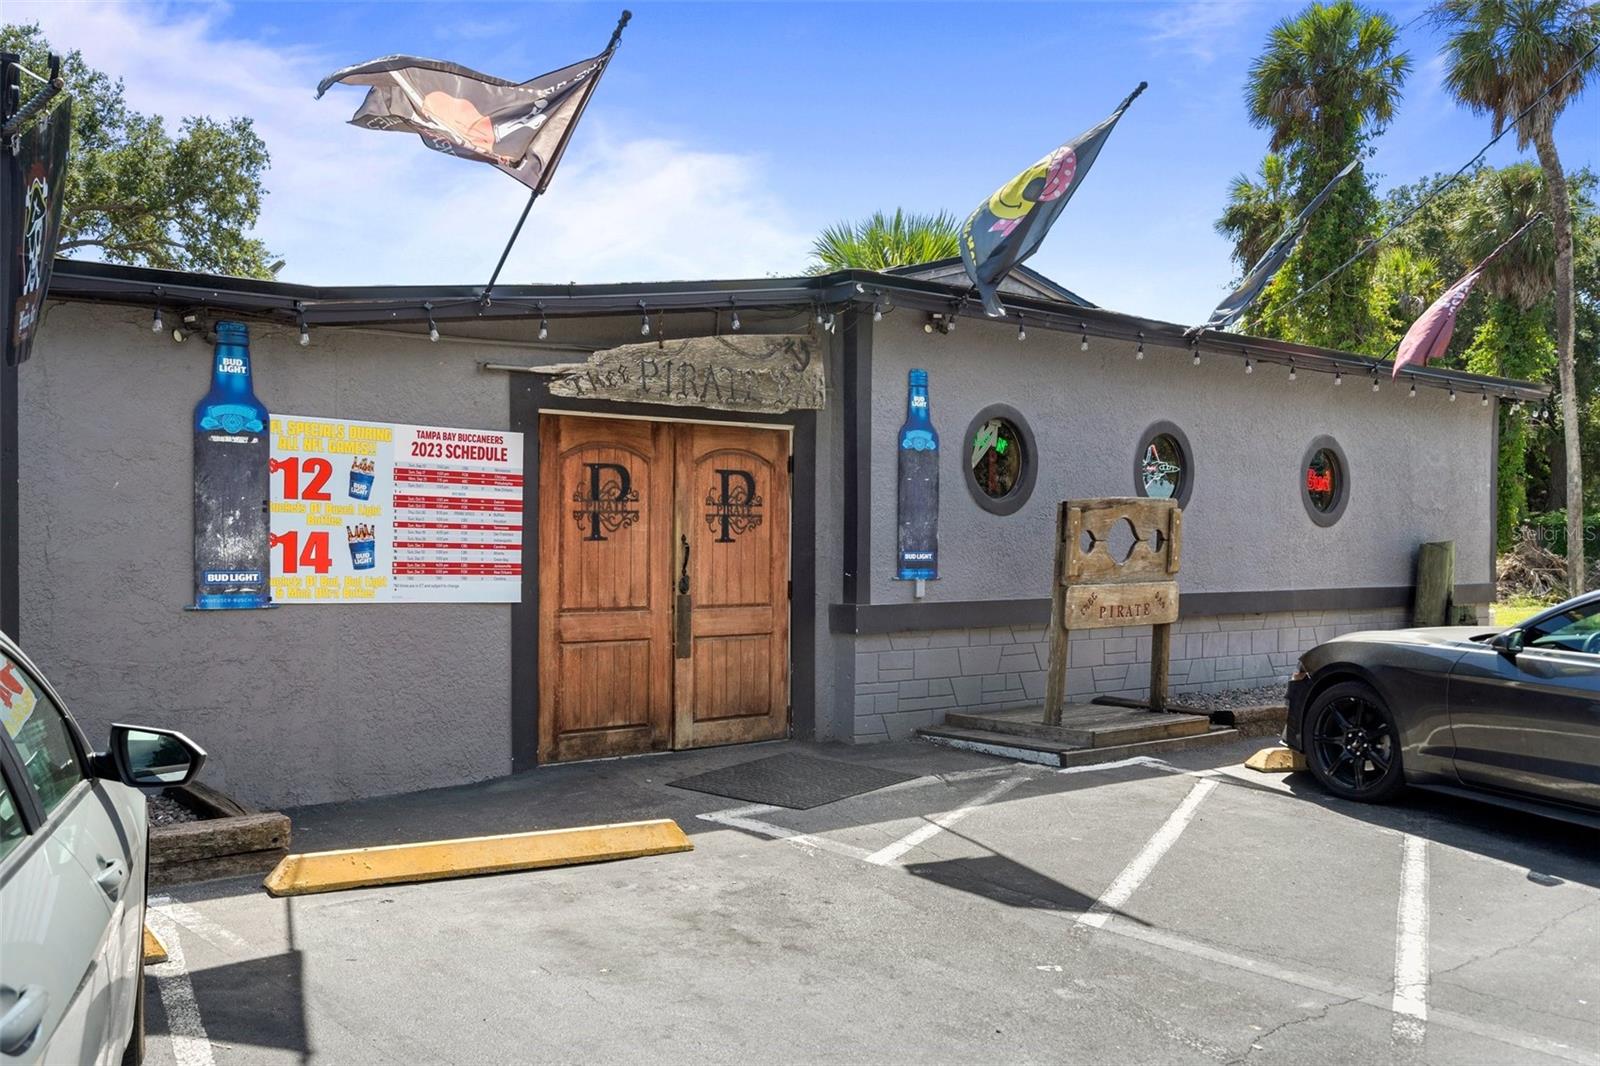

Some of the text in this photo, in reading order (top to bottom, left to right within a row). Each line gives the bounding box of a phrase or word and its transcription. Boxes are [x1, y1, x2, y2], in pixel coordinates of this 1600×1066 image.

[222, 358, 243, 366] BUD
[218, 364, 246, 374] LIGHT
[270, 420, 392, 442] FL SPECIALS DURING
[416, 430, 504, 445] TAMPA BAY BUCCANEERS
[278, 436, 298, 451] ALL
[303, 438, 324, 453] NFL
[412, 442, 508, 462] 2023 SCHEDULE
[270, 502, 306, 513] uckets
[584, 463, 631, 541] P
[585, 502, 628, 512] PIRATE
[715, 469, 756, 542] P
[716, 504, 753, 515] PIRATE
[306, 514, 343, 526] Bottles
[230, 574, 258, 582] LIGHT
[343, 588, 376, 600] Bottles
[1100, 602, 1152, 619] PIRATE
